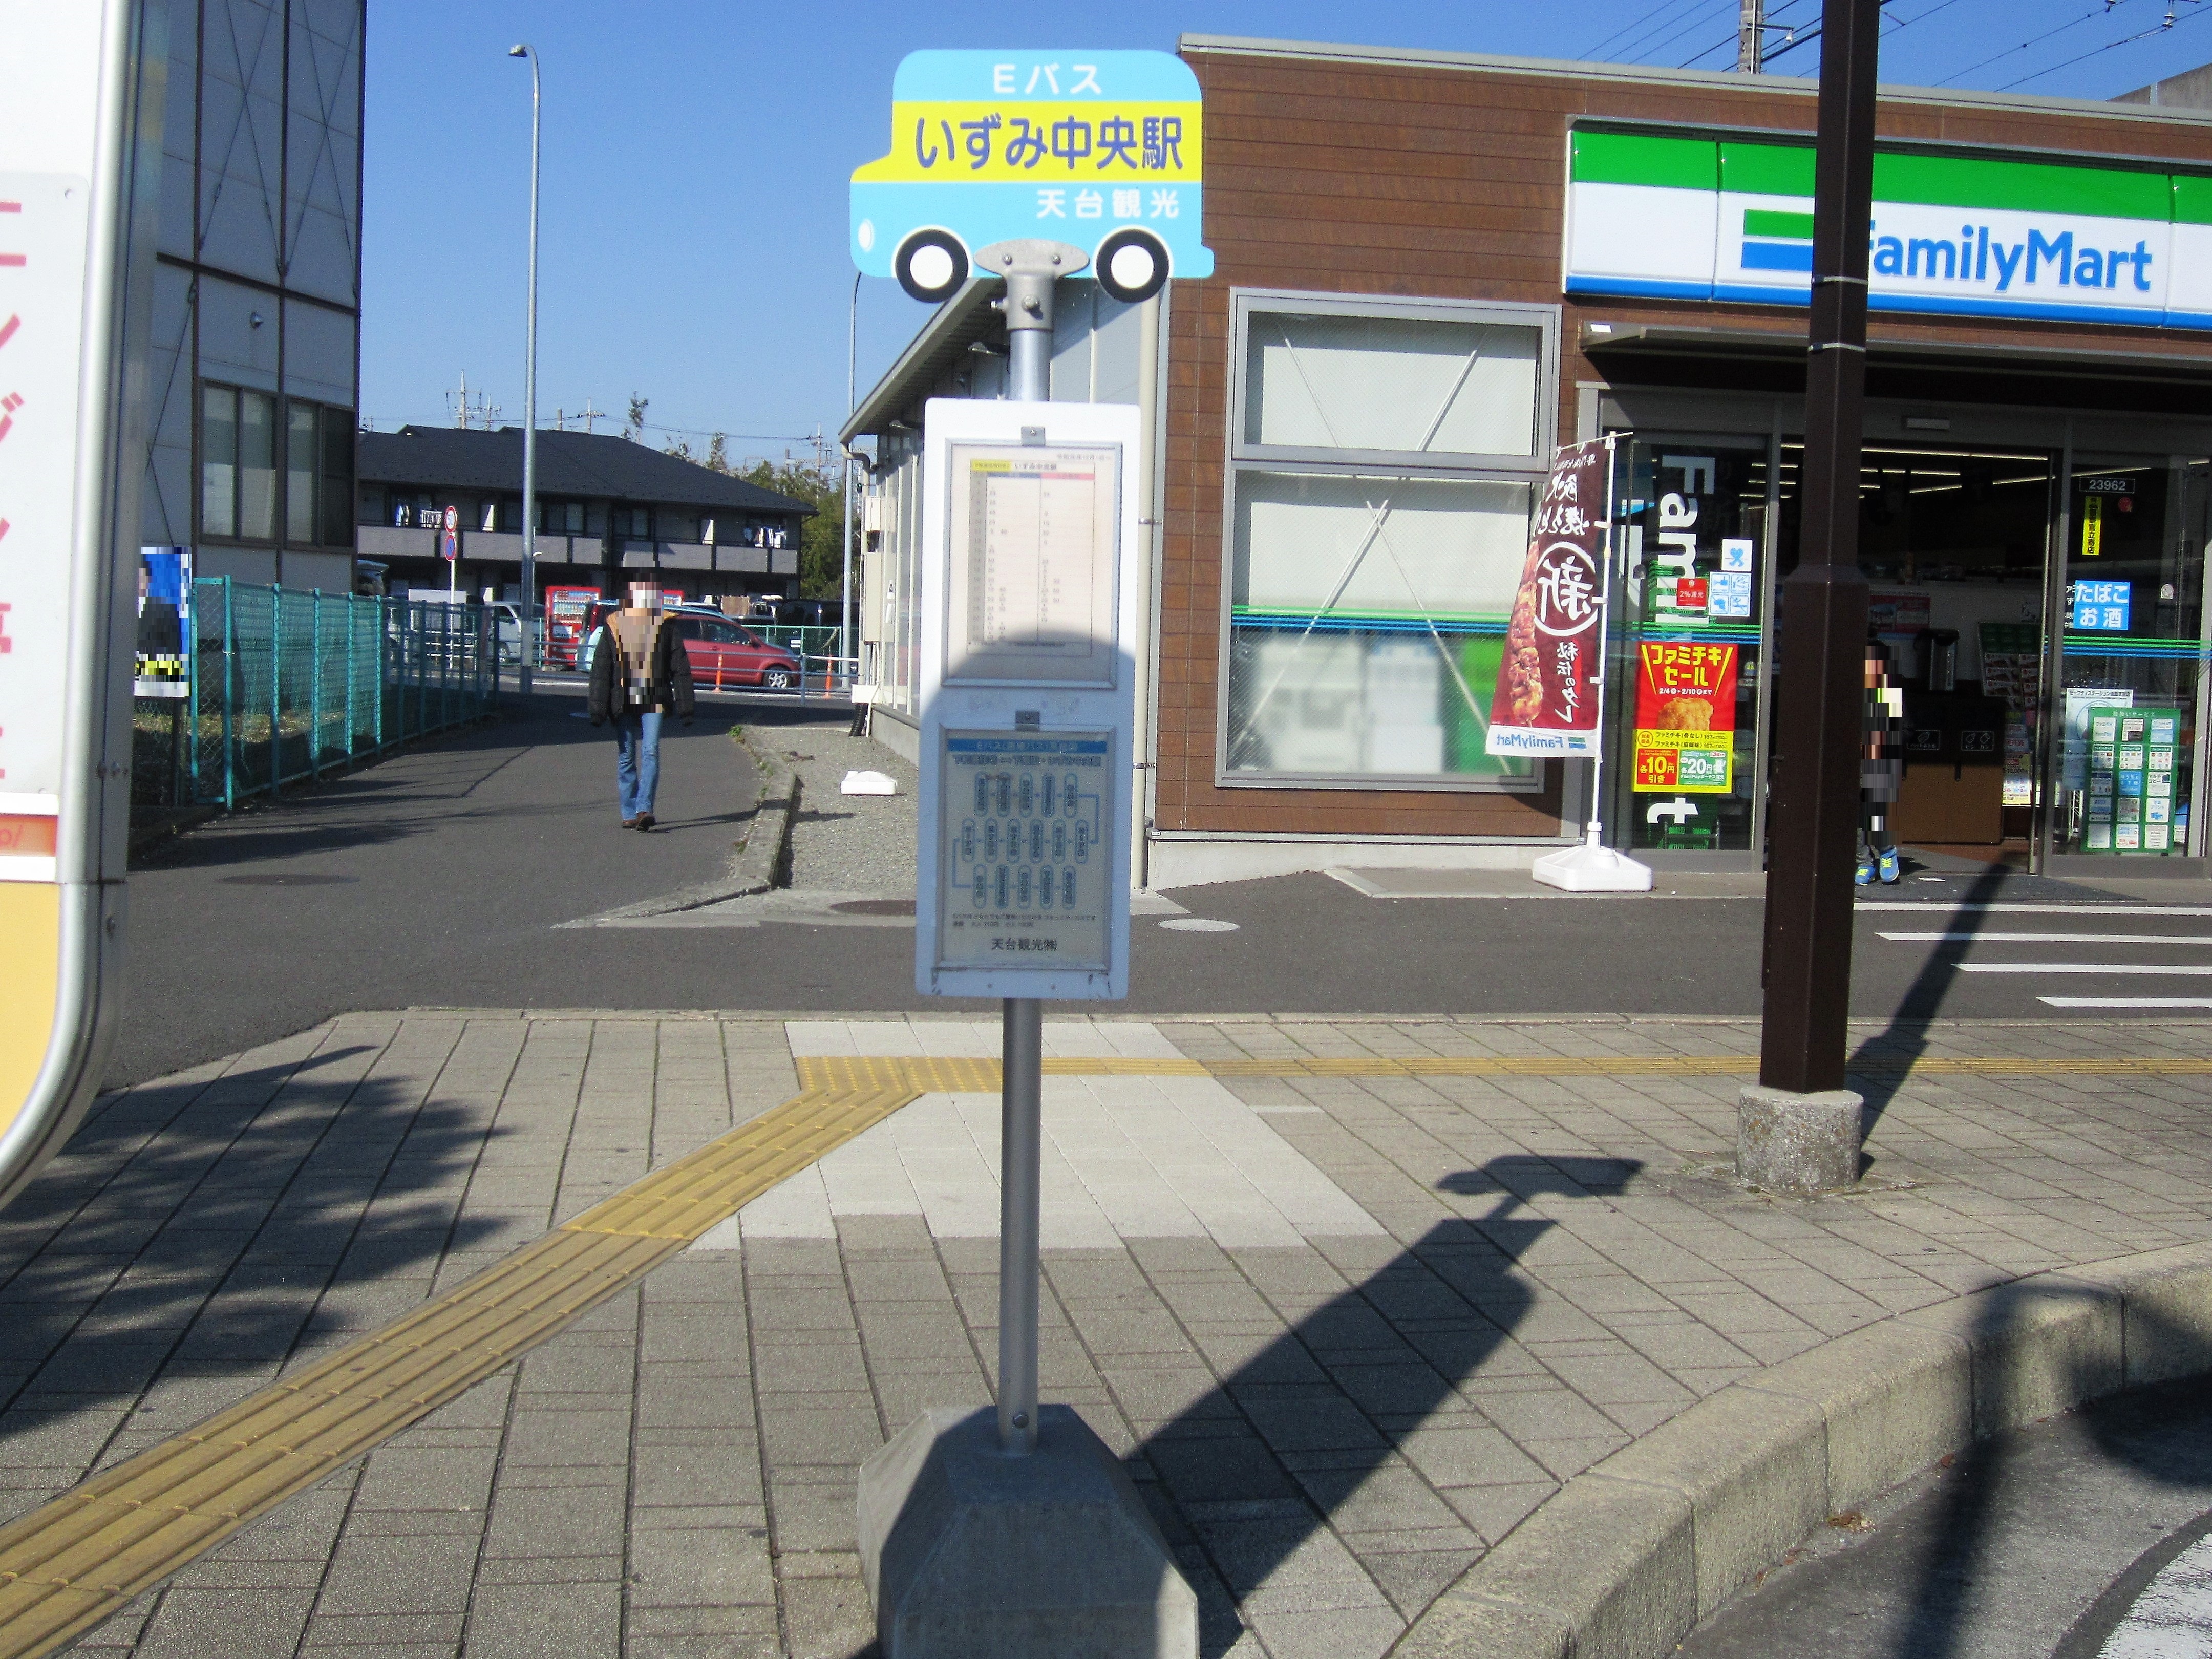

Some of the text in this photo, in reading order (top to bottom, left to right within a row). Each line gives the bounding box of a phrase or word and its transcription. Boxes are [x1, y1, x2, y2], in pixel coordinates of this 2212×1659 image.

[993, 63, 1101, 94] Eバス
[916, 113, 1183, 170] いずみ中央駅
[1036, 189, 1179, 218] 天台観光
[1869, 220, 2153, 293] amilyMart
[2089, 480, 2125, 491] 23962
[2076, 584, 2128, 603] たばこ
[2080, 608, 2122, 628] お酒
[1651, 645, 1722, 666] ファミチキ
[1664, 667, 1709, 686] セール
[1640, 756, 1675, 774] 各10円
[1648, 774, 1665, 783] 引き
